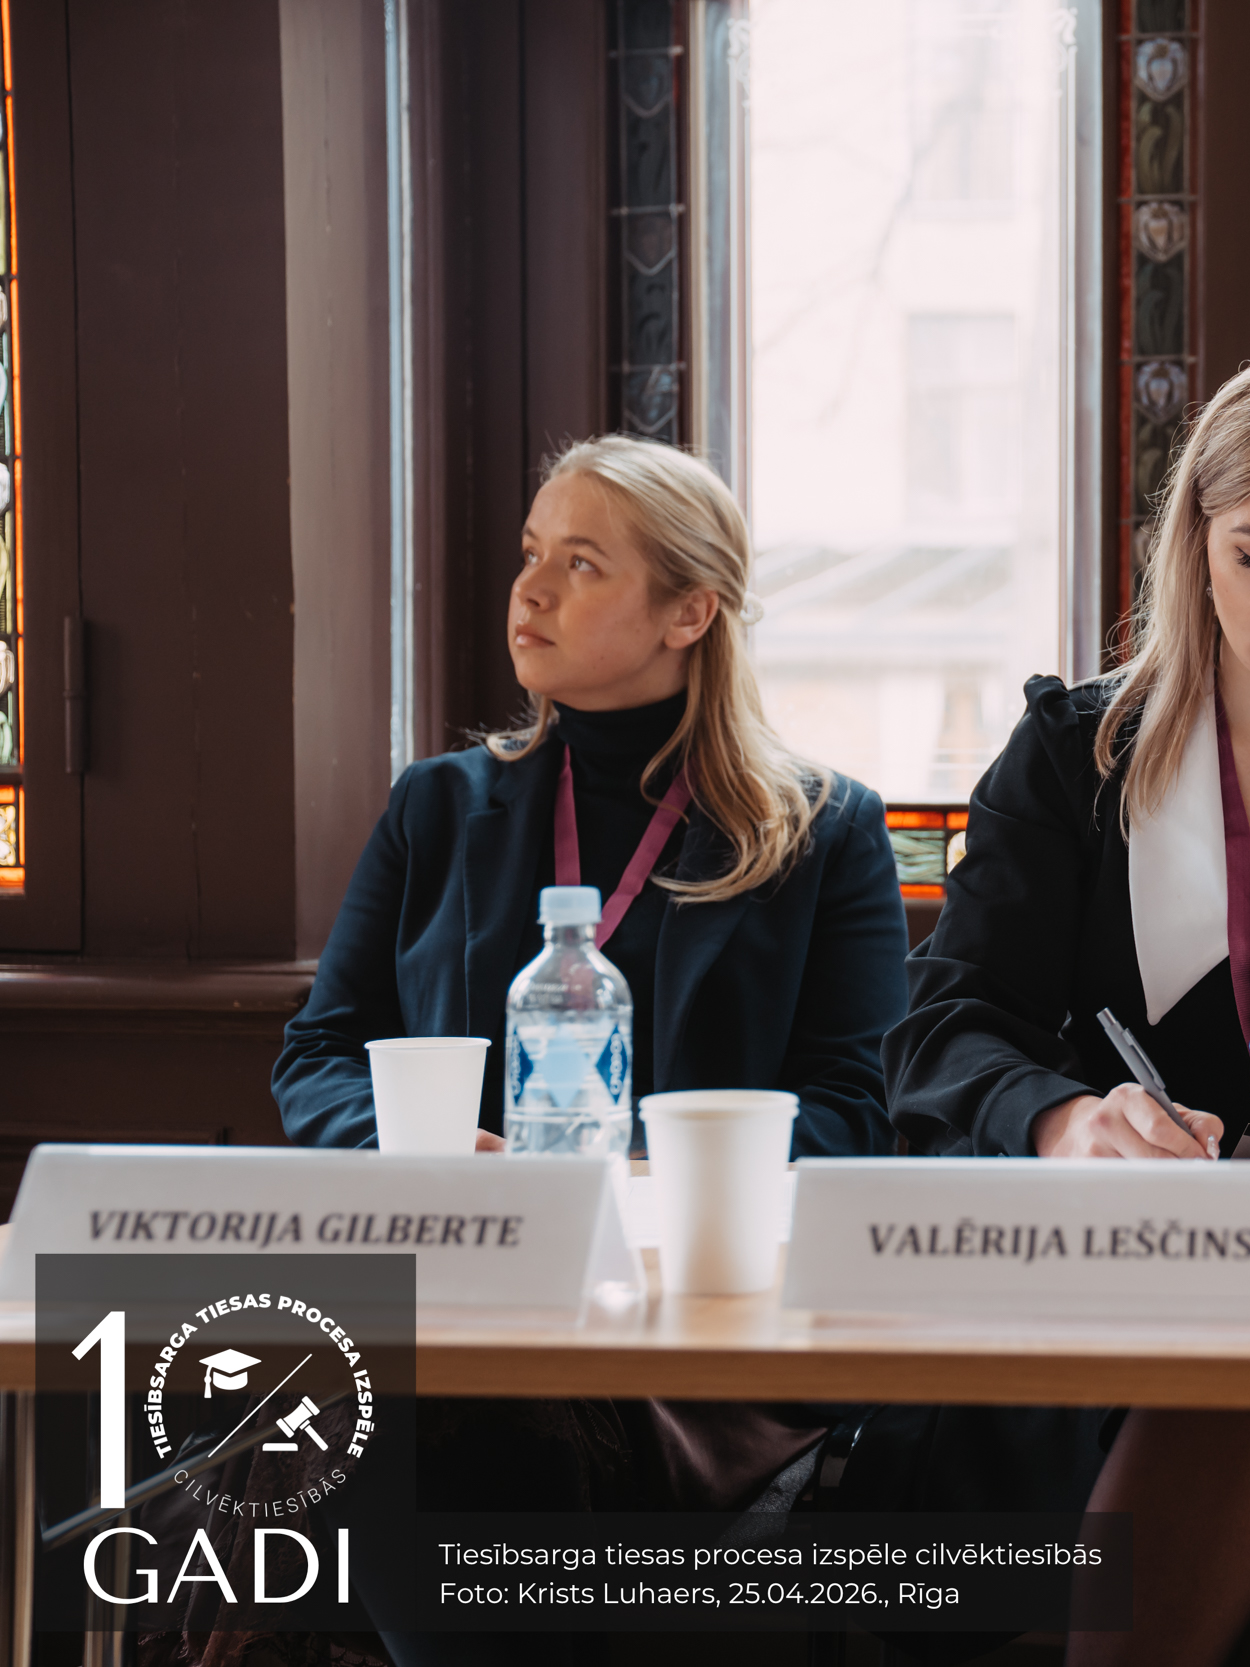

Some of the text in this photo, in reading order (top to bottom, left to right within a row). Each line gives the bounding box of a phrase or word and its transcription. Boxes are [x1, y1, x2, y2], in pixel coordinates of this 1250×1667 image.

[89, 1209, 525, 1250] VIKTORIJA GILBERTE
[868, 1219, 1068, 1264] VALĒRIJA
